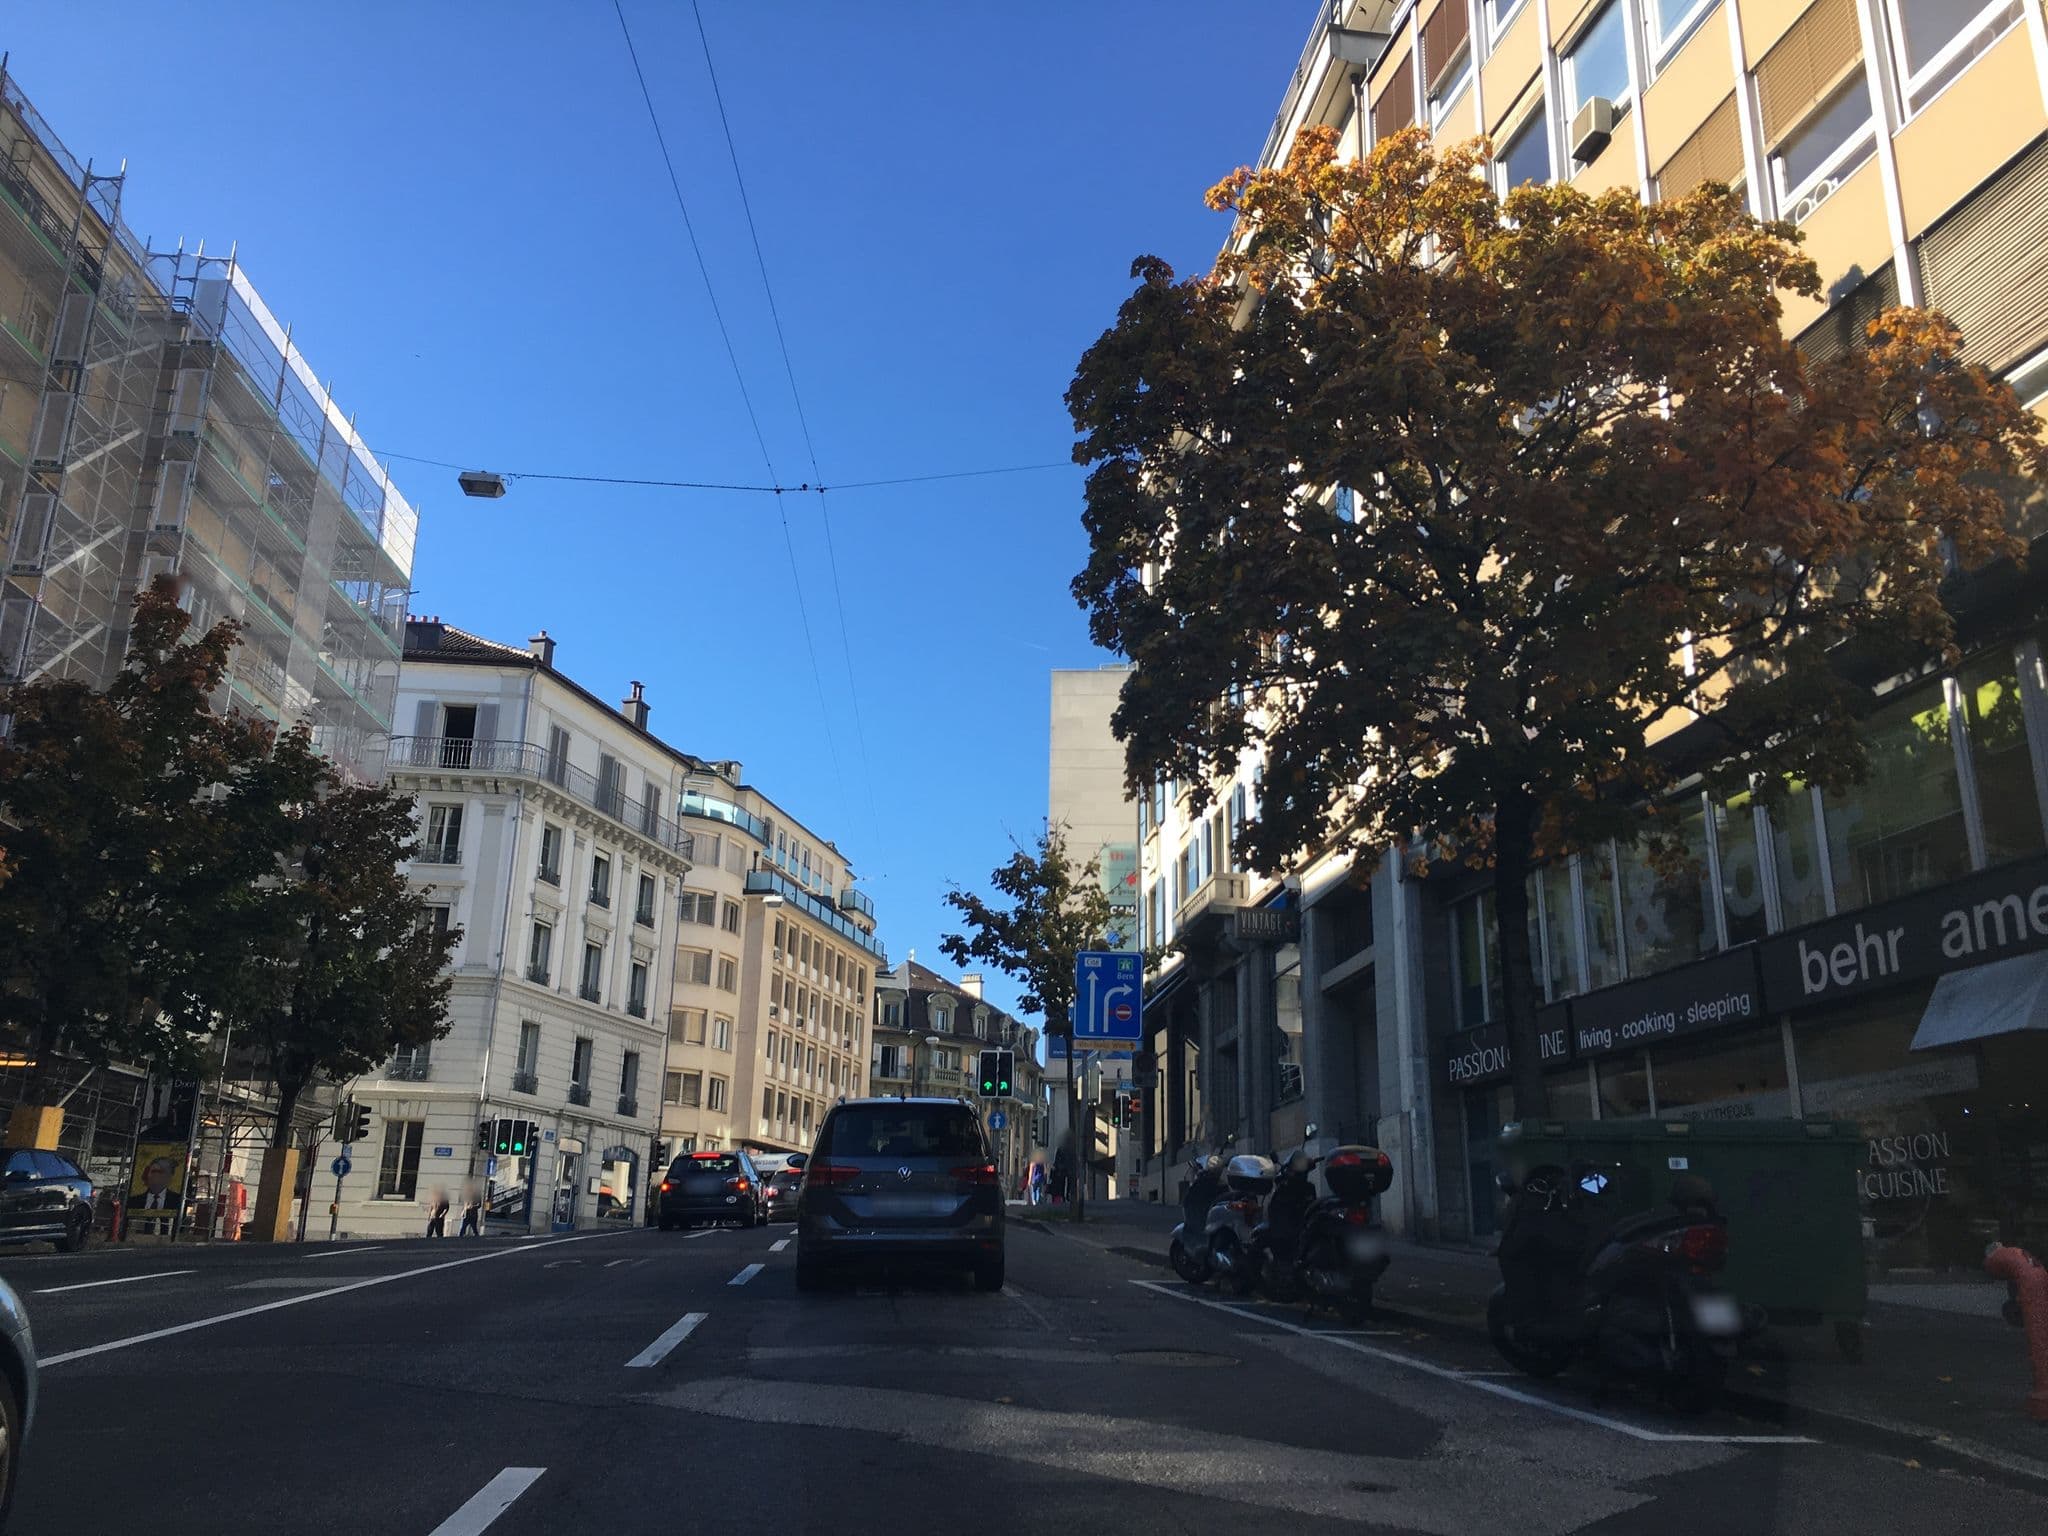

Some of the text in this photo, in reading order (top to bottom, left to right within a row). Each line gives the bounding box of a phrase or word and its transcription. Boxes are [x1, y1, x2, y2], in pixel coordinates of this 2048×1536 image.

[1241, 911, 1281, 932] VINTAGE
[1798, 923, 1905, 996] behr
[1579, 993, 1752, 1050] living cooking sleeping
[1448, 1046, 1505, 1082] PASSION
[1868, 1131, 1951, 1165] ASSION
[1864, 1167, 1950, 1199] CUISINE
